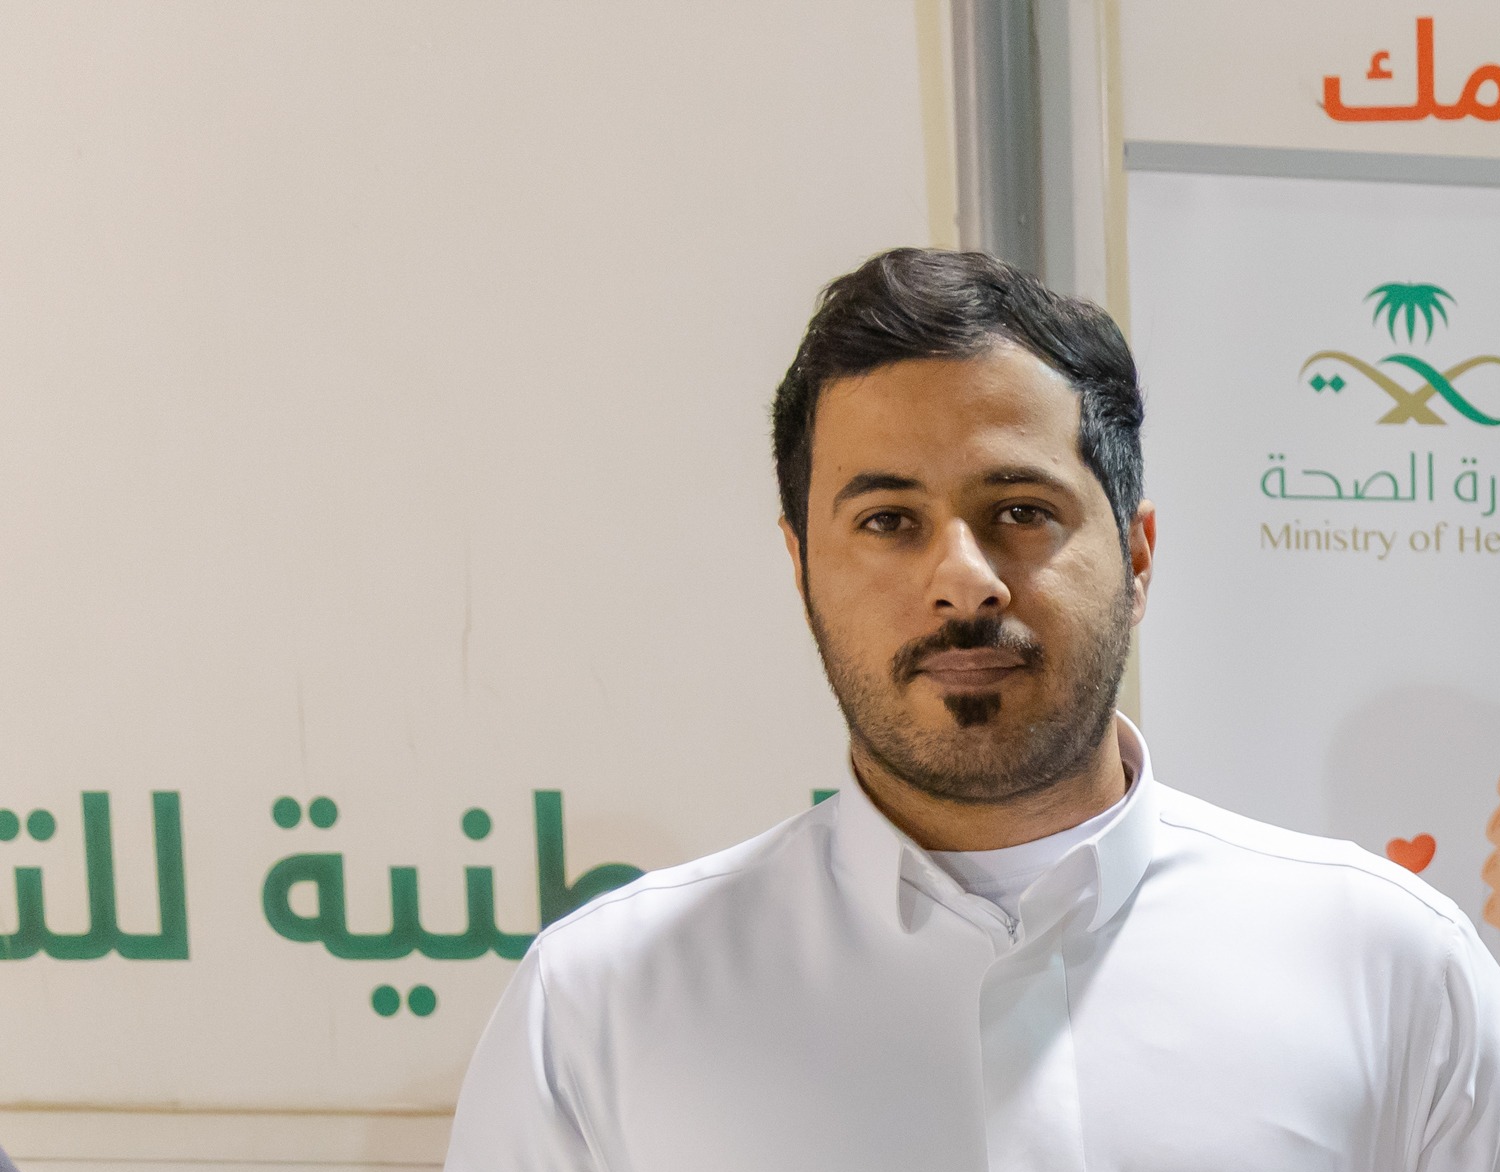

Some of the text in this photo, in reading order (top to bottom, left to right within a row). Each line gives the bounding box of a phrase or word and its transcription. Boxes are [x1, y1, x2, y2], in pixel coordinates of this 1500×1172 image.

[1261, 451, 1434, 501] الصحة
[1260, 519, 1396, 560] Ministry
[1409, 521, 1448, 552] of
